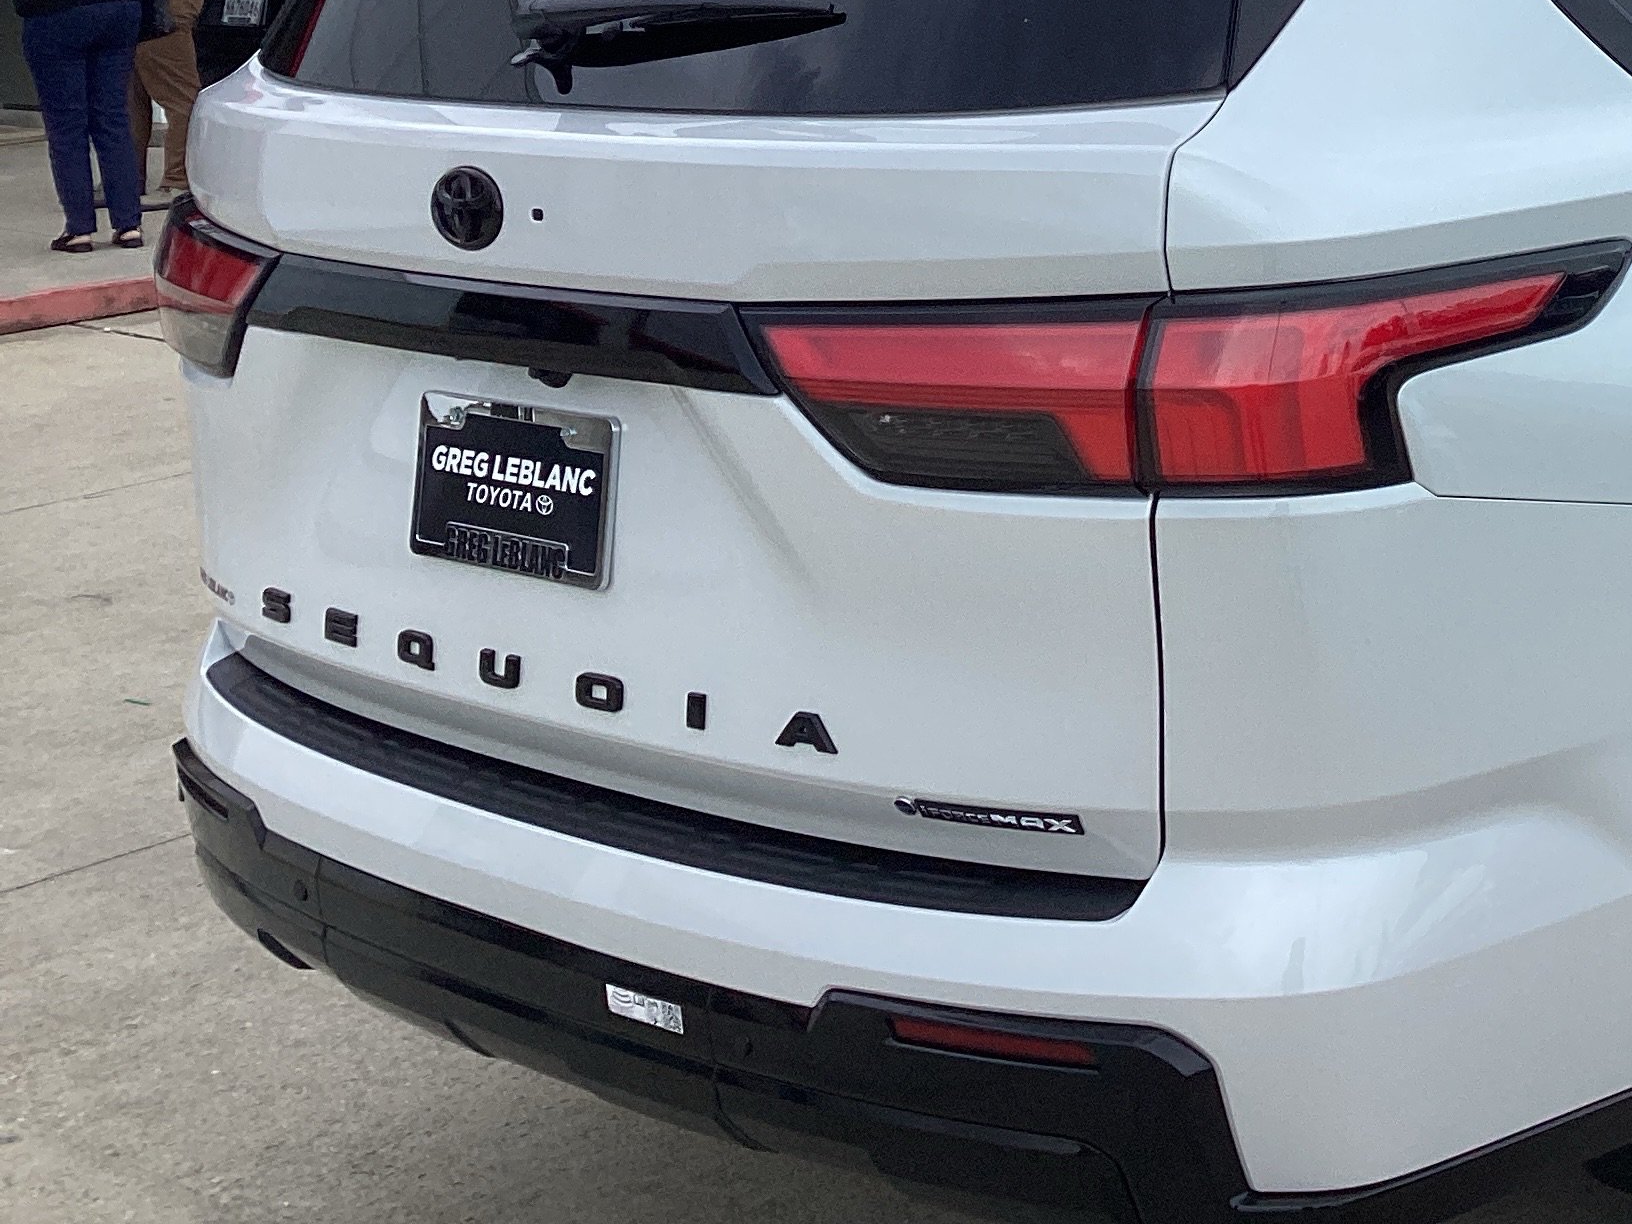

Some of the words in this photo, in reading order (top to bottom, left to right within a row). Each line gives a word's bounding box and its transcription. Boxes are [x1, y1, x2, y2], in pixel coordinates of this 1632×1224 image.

[431, 444, 489, 478] GREG
[491, 454, 597, 497] LEBLANC
[466, 482, 532, 513] TOYOTA
[444, 525, 491, 564] GREG
[262, 586, 838, 755] SEQUOIA
